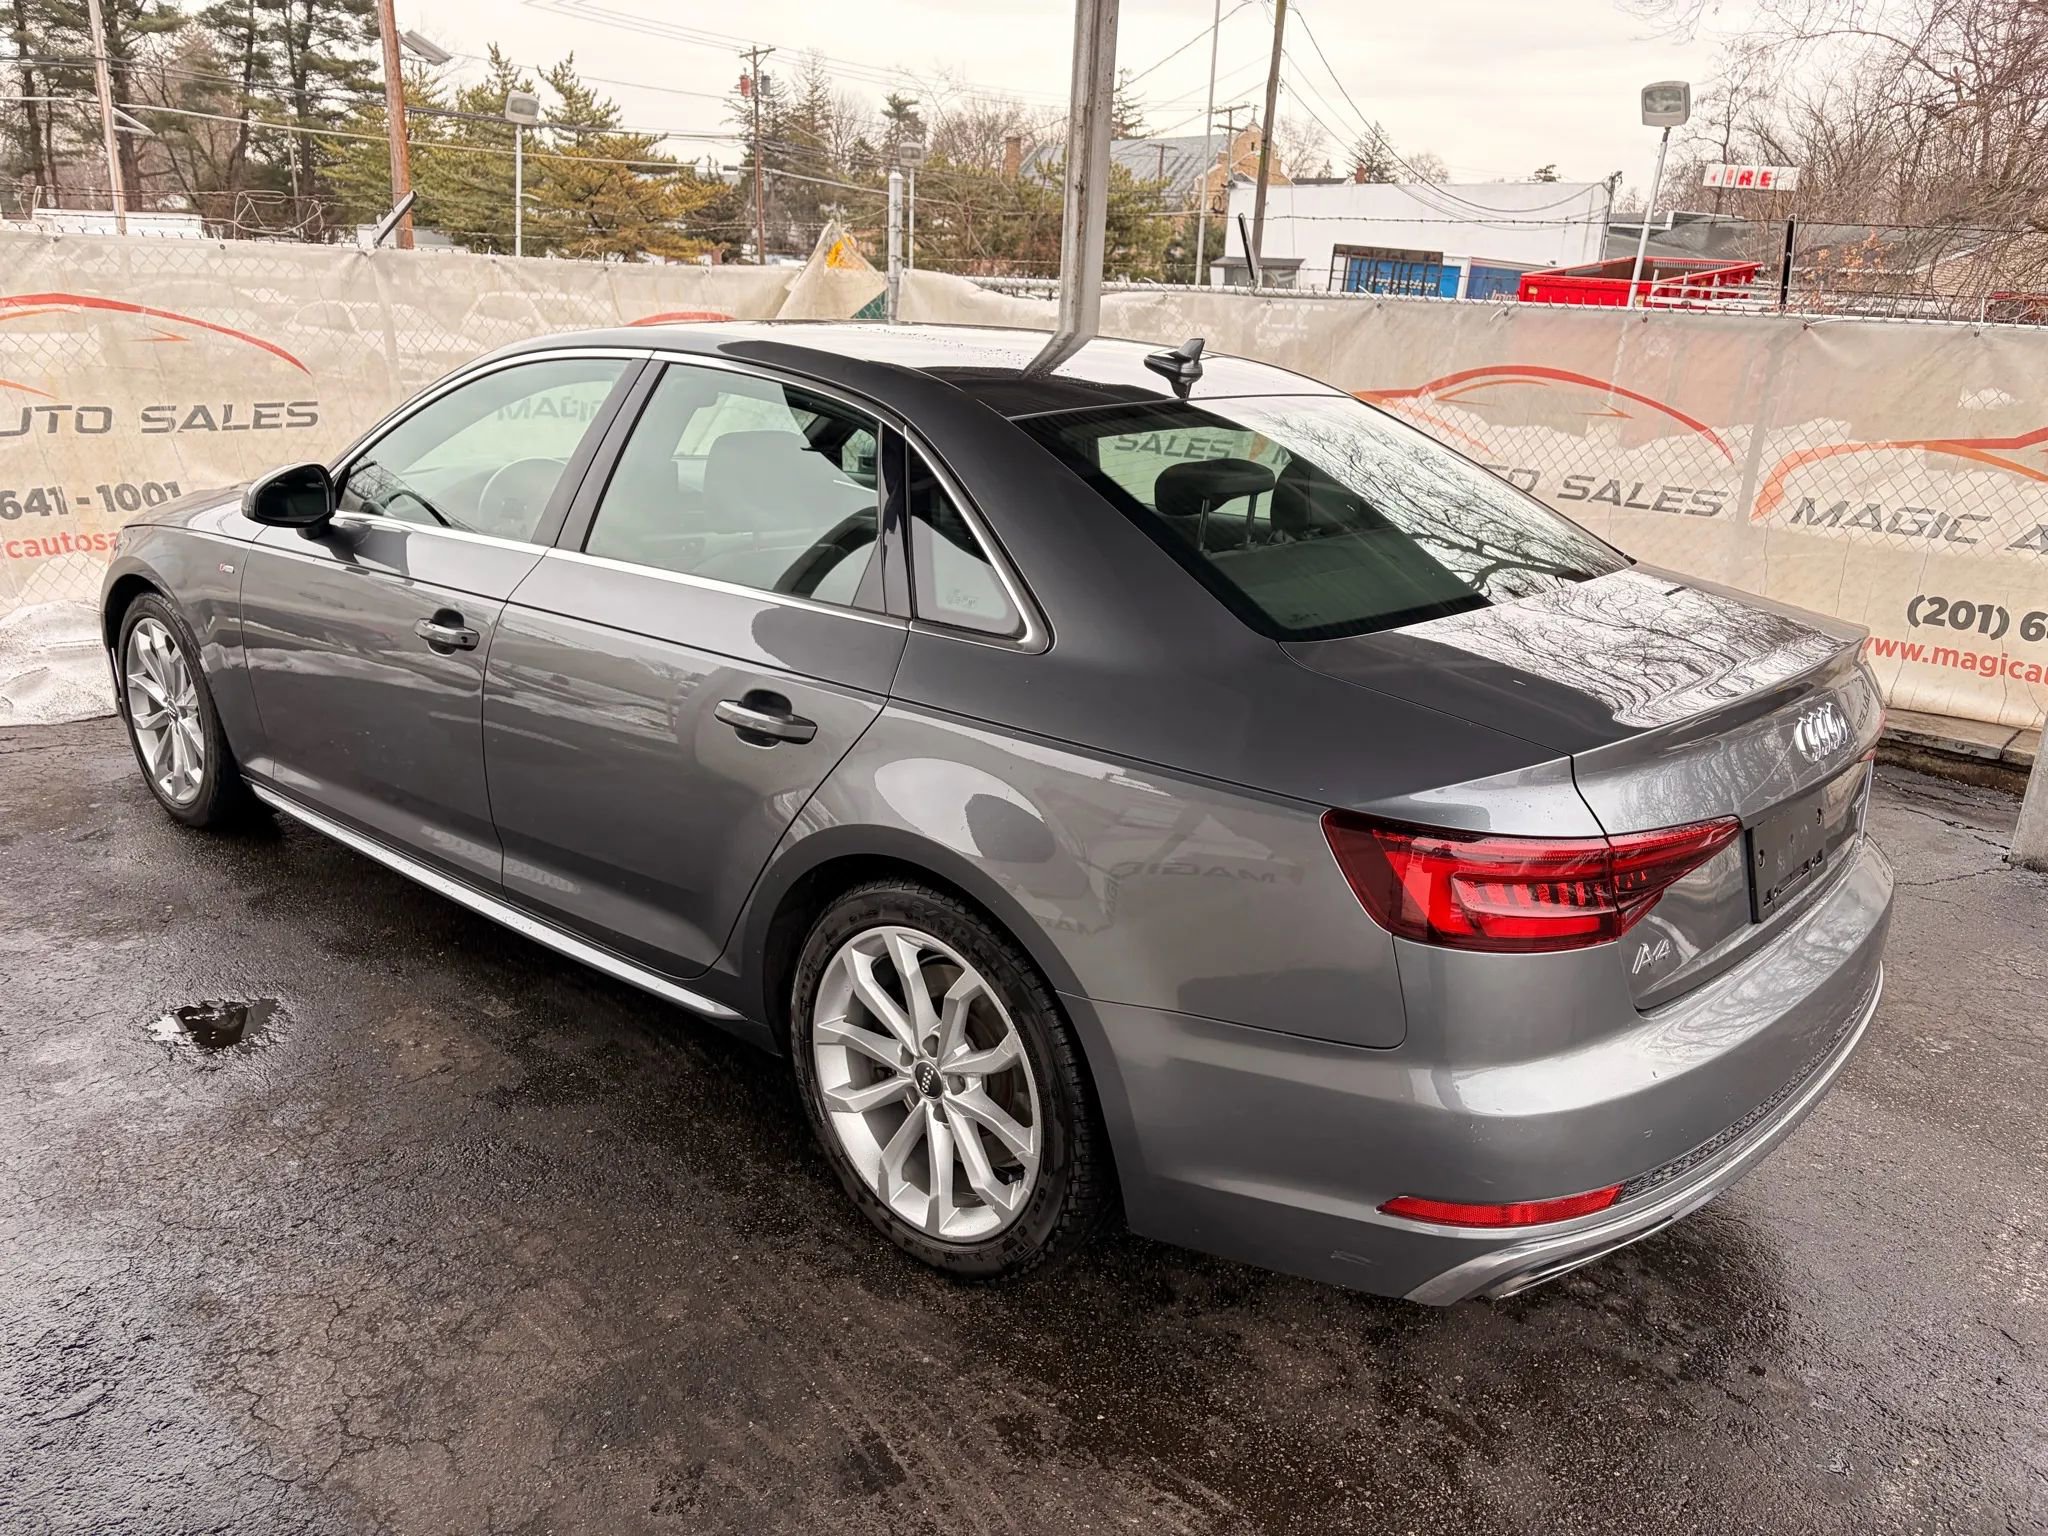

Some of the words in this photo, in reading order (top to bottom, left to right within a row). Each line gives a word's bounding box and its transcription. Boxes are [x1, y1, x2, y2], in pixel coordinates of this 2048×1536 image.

[1710, 170, 1772, 187] IRE
[141, 401, 318, 434] SALES
[1114, 434, 1234, 460] SALES
[1557, 474, 1729, 517] SALES
[1790, 497, 1992, 545] MAGIC
[1907, 595, 2010, 641] (201)
[1863, 637, 2048, 685] ww.magica
[1631, 938, 1671, 975] A4
